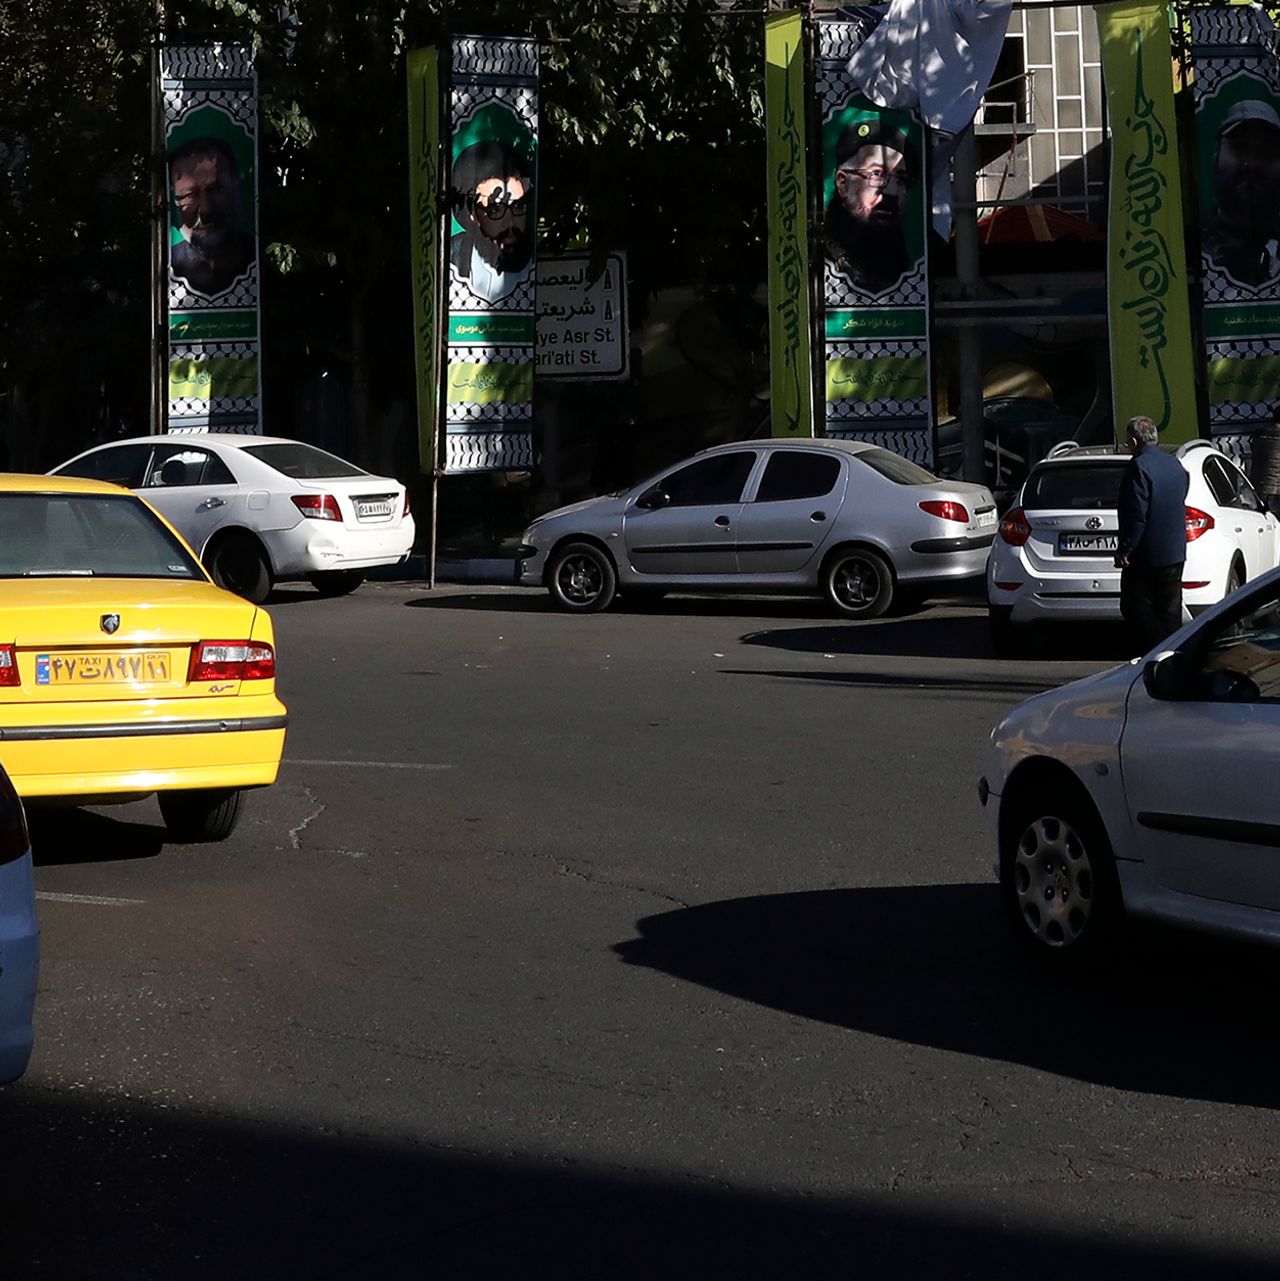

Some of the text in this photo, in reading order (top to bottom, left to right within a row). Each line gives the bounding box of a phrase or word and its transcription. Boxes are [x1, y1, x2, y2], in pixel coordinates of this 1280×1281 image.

[563, 329, 590, 344] Asr
[594, 327, 615, 342] St.
[579, 349, 601, 365] St.
[79, 657, 102, 665] TAXI
[148, 660, 167, 679] ۱۱
